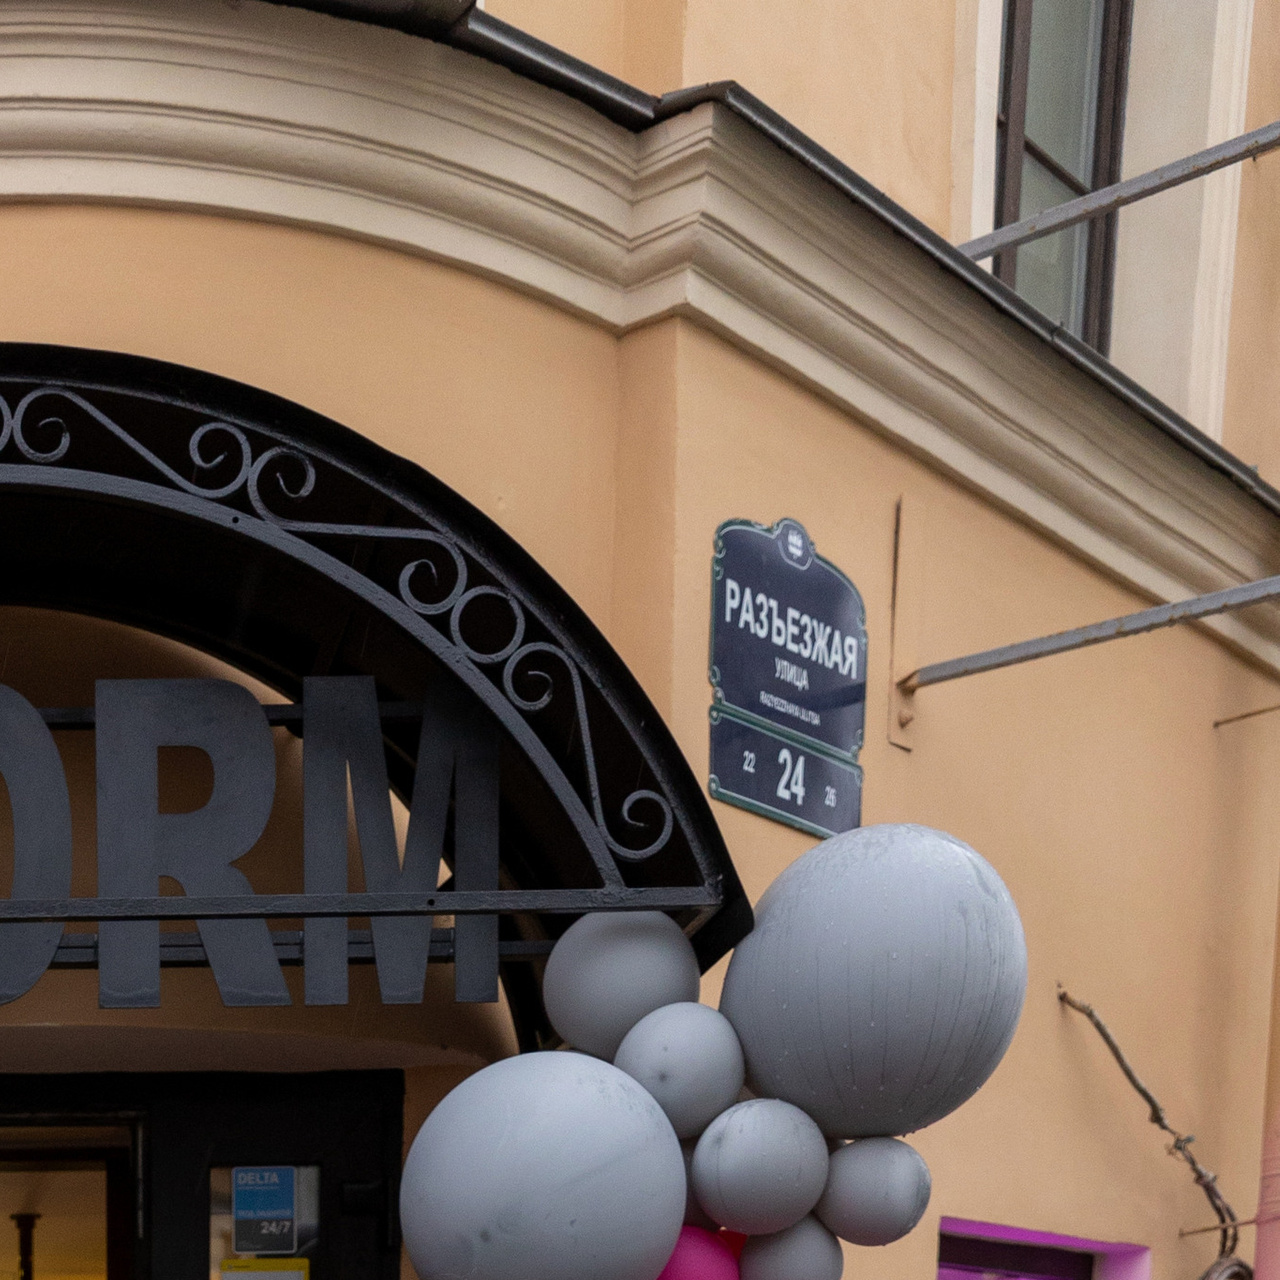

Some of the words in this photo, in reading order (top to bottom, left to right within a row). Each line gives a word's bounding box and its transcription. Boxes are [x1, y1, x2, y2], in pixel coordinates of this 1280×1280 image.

[725, 578, 858, 680] РАЗЪЕЗЖАЯ
[775, 657, 810, 691] УЛИЦА
[743, 750, 756, 773] 22
[776, 748, 805, 806] 24
[237, 1171, 279, 1185] DELTA
[261, 1220, 291, 1234] 24/7
